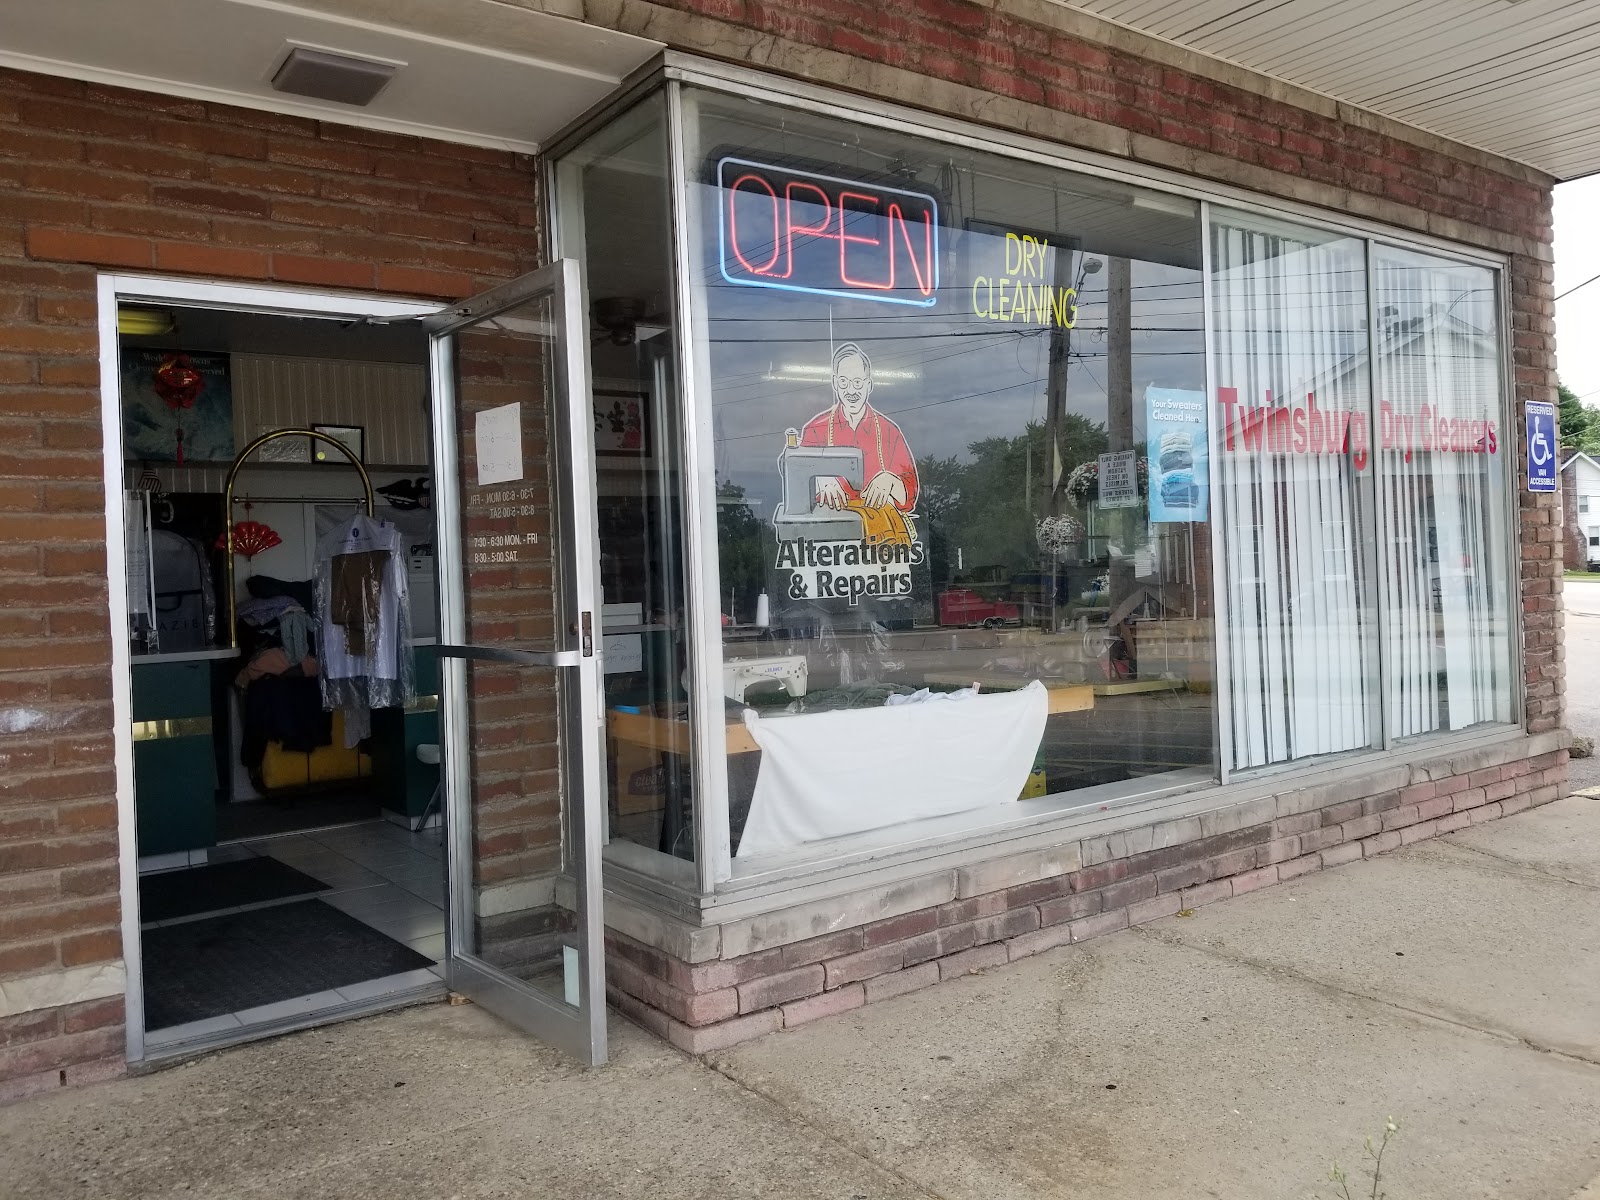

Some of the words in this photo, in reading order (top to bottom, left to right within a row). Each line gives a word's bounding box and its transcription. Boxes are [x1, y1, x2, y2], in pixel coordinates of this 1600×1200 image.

[730, 174, 931, 296] OPEN
[1005, 232, 1048, 280] DRY
[972, 275, 1078, 329] CLEANING
[1151, 398, 1167, 408] Your
[1167, 398, 1203, 411] Sweaters
[1152, 409, 1184, 422] Cleaned
[1527, 404, 1553, 415] RESERVED
[1218, 387, 1367, 471] Twinsburg
[1381, 400, 1413, 463] Dry
[1420, 403, 1497, 454] Cleaners
[1538, 468, 1547, 476] VAN
[474, 537, 486, 547] 7:30
[490, 536, 503, 546] 6:30
[505, 534, 521, 546] MON.
[474, 553, 486, 563] 8:30
[491, 552, 504, 562] 5:00
[776, 536, 923, 568] Alterations
[789, 573, 809, 599] &
[816, 566, 912, 604] Repairs
